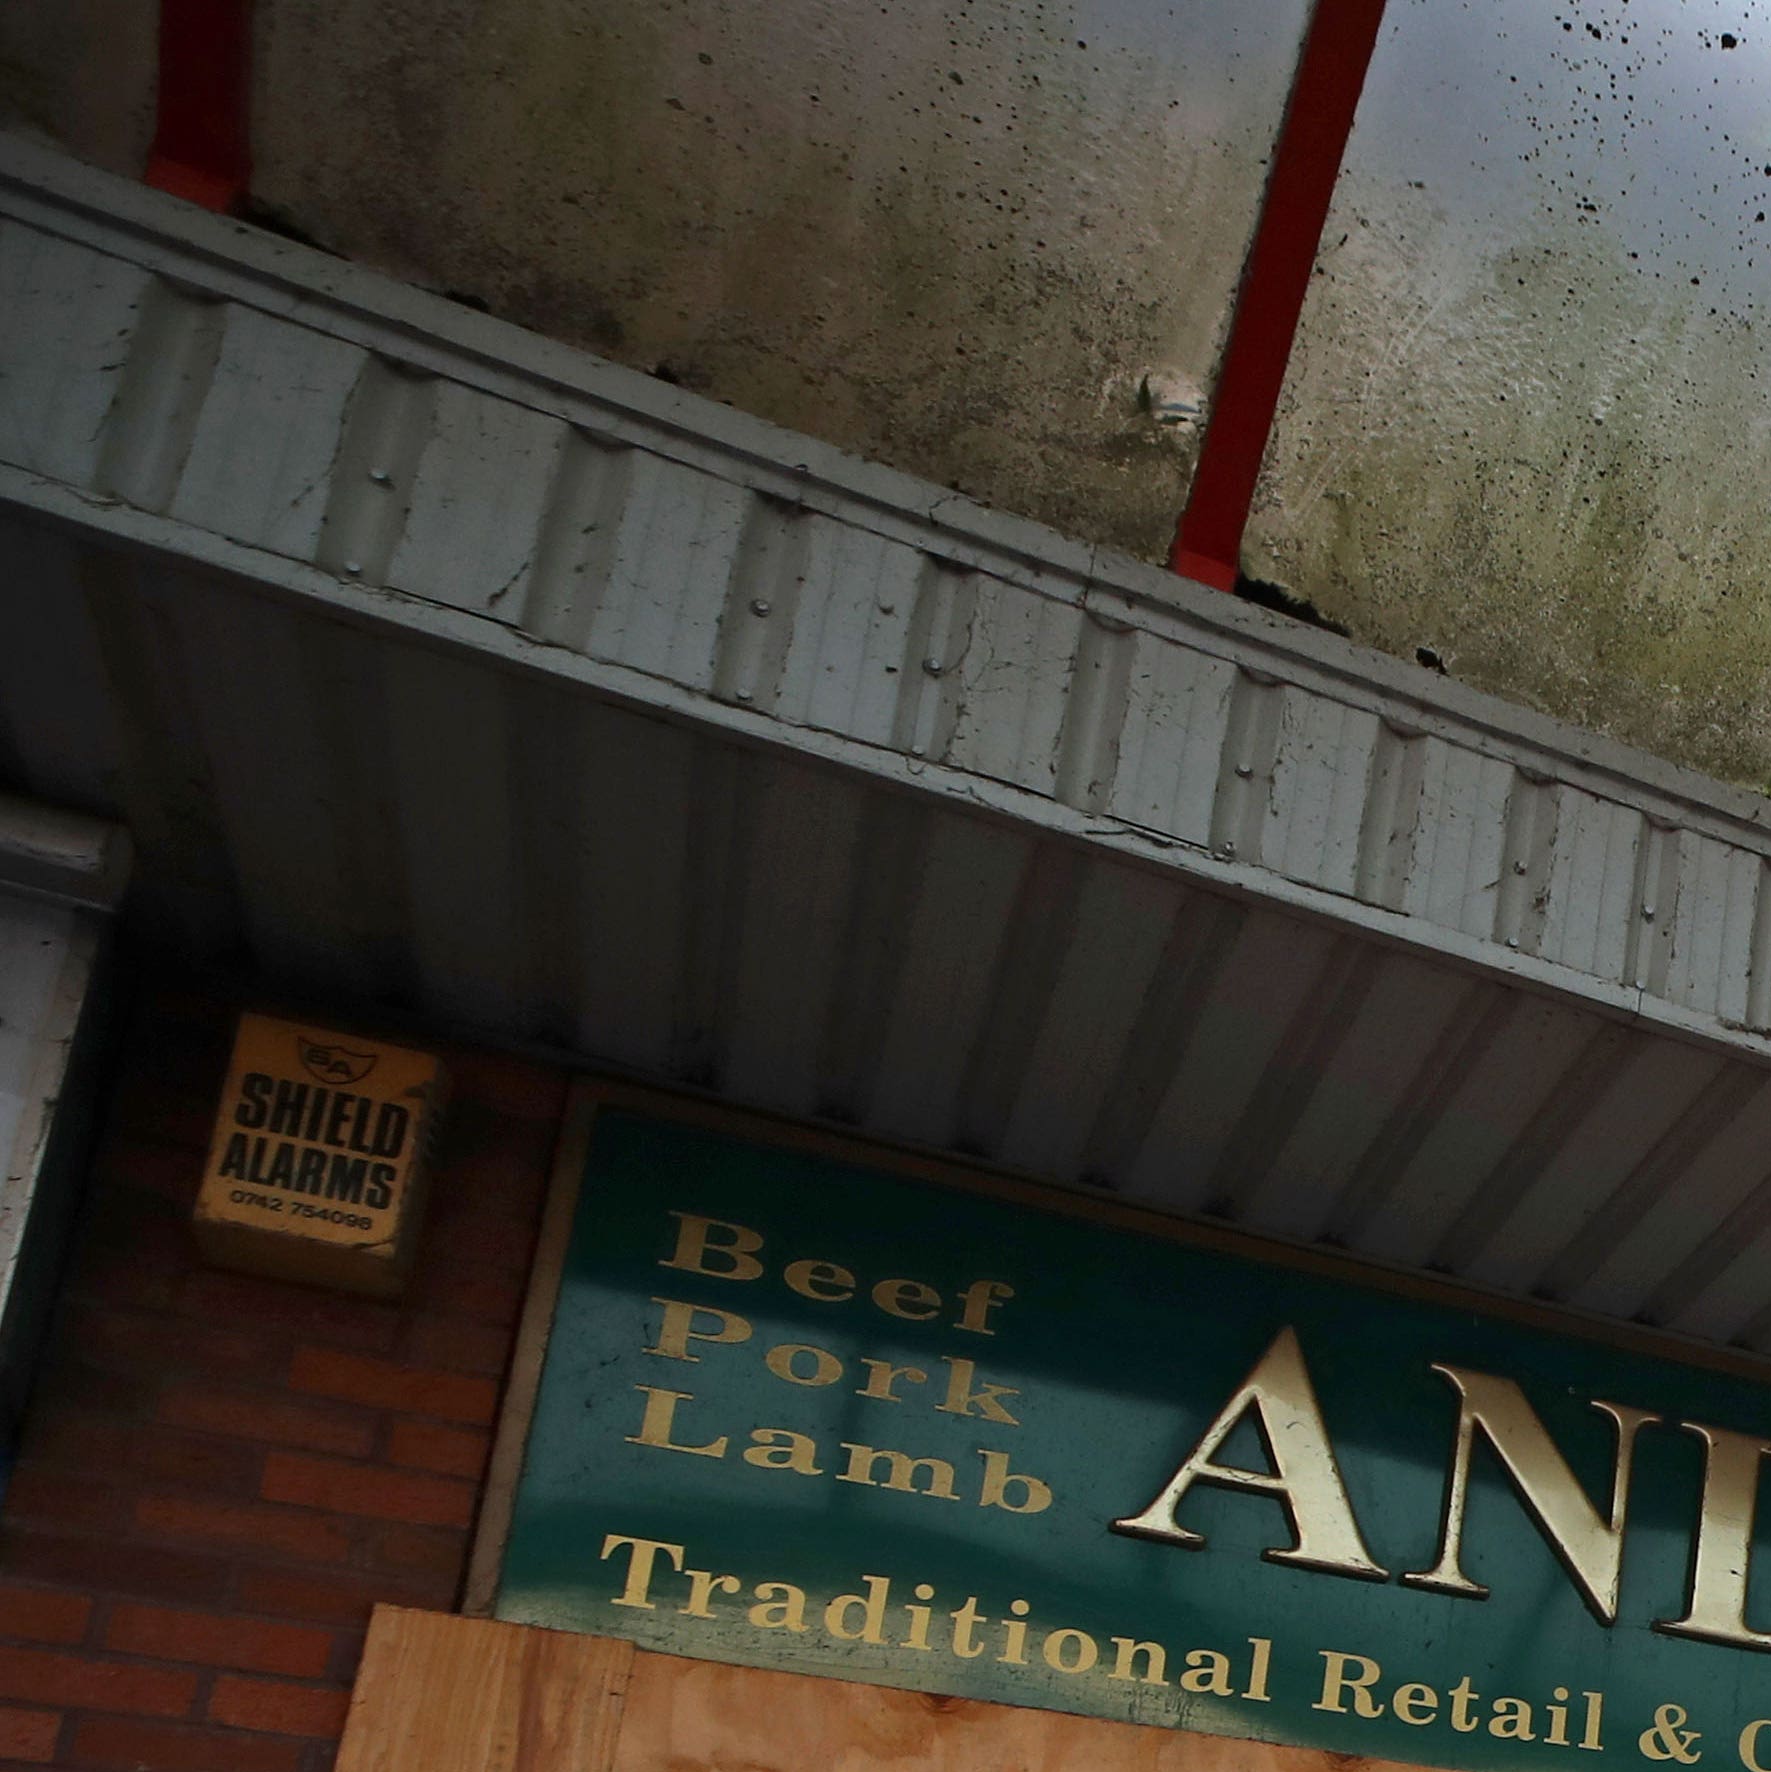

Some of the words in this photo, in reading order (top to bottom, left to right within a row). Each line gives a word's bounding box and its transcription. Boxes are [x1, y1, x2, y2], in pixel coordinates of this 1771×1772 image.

[218, 1131, 397, 1210] ALARMS
[234, 1071, 410, 1159] SHIELD
[229, 1189, 284, 1213] 0742
[657, 1210, 1016, 1336] Beef
[641, 1296, 1022, 1428] Pork
[623, 1383, 1055, 1515] Lamb
[599, 1532, 1272, 1703] Traditional
[1311, 1650, 1605, 1753] Retail
[1636, 1702, 1703, 1766] &
